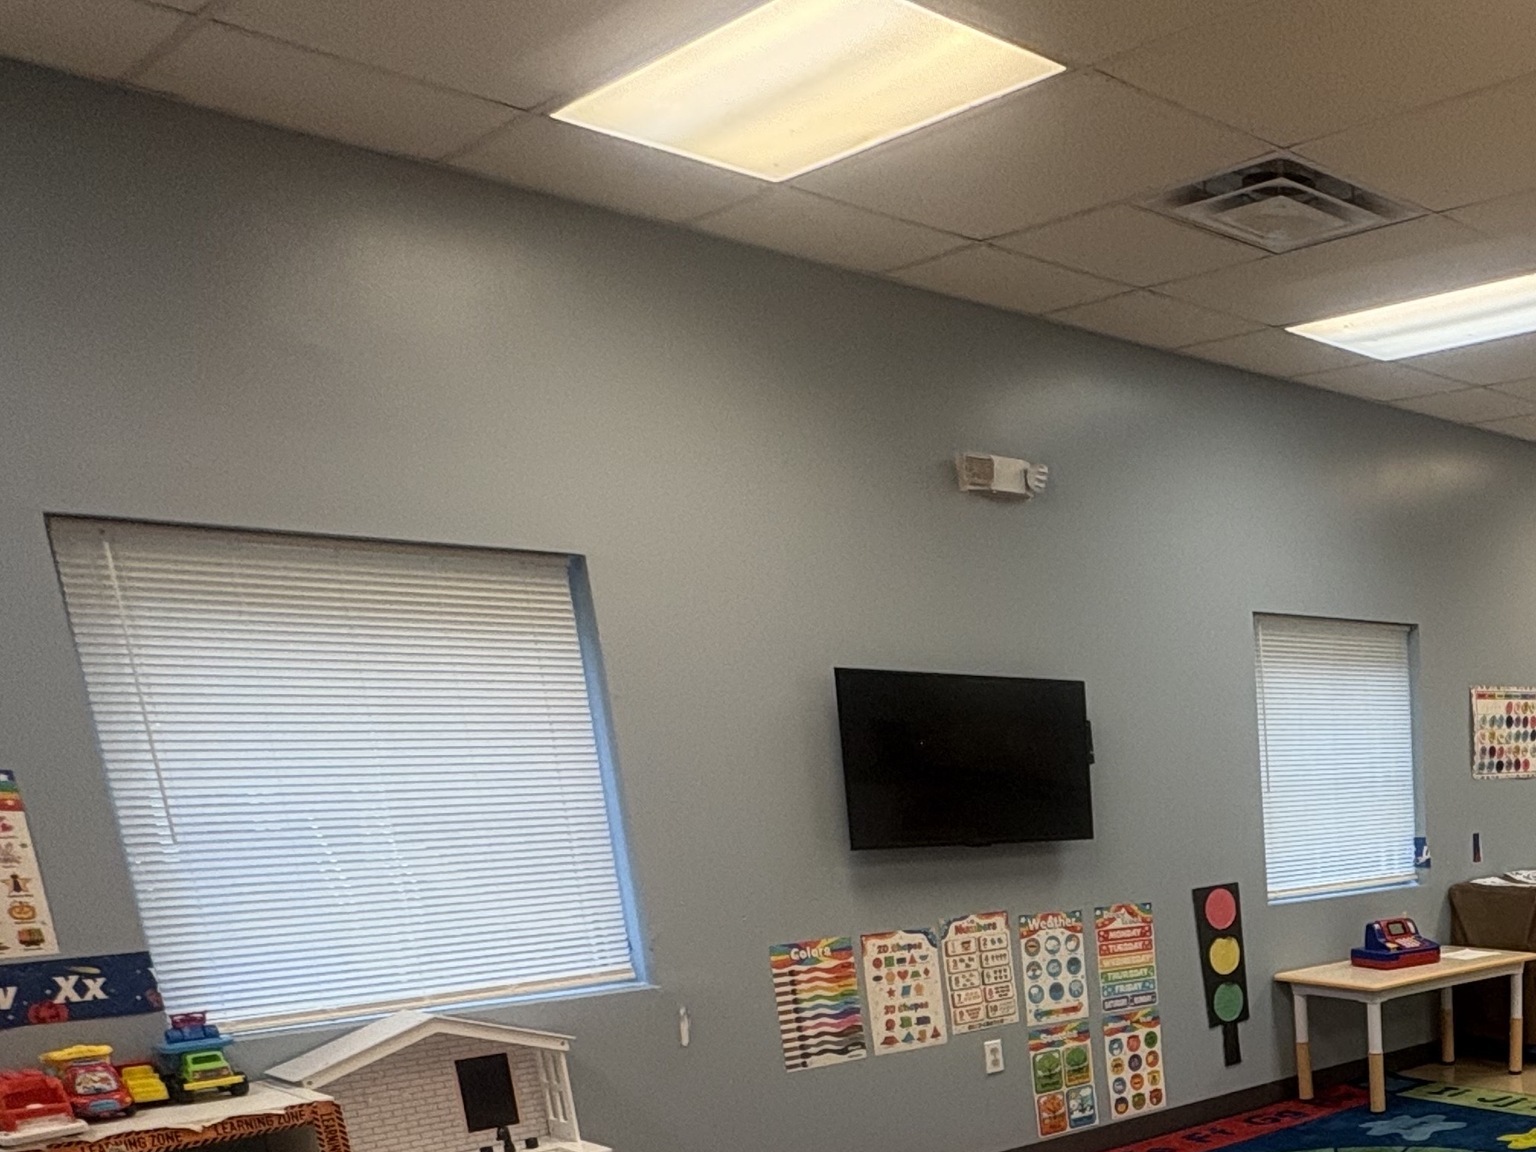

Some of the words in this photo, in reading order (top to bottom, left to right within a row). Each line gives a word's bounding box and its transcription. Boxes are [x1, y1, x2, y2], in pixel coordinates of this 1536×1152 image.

[954, 921, 998, 935] Numbers
[1027, 915, 1077, 931] Weather
[1108, 928, 1143, 940] MONDAY
[789, 945, 832, 962] Colors
[1108, 942, 1144, 953] TUESDAY
[1107, 968, 1149, 980] THURSDAY
[52, 974, 109, 1004] Xx
[1115, 982, 1144, 993] FRIDAY
[213, 1114, 275, 1136] LEARNING
[277, 1108, 306, 1126] ZONE
[150, 1131, 183, 1148] ZONE
